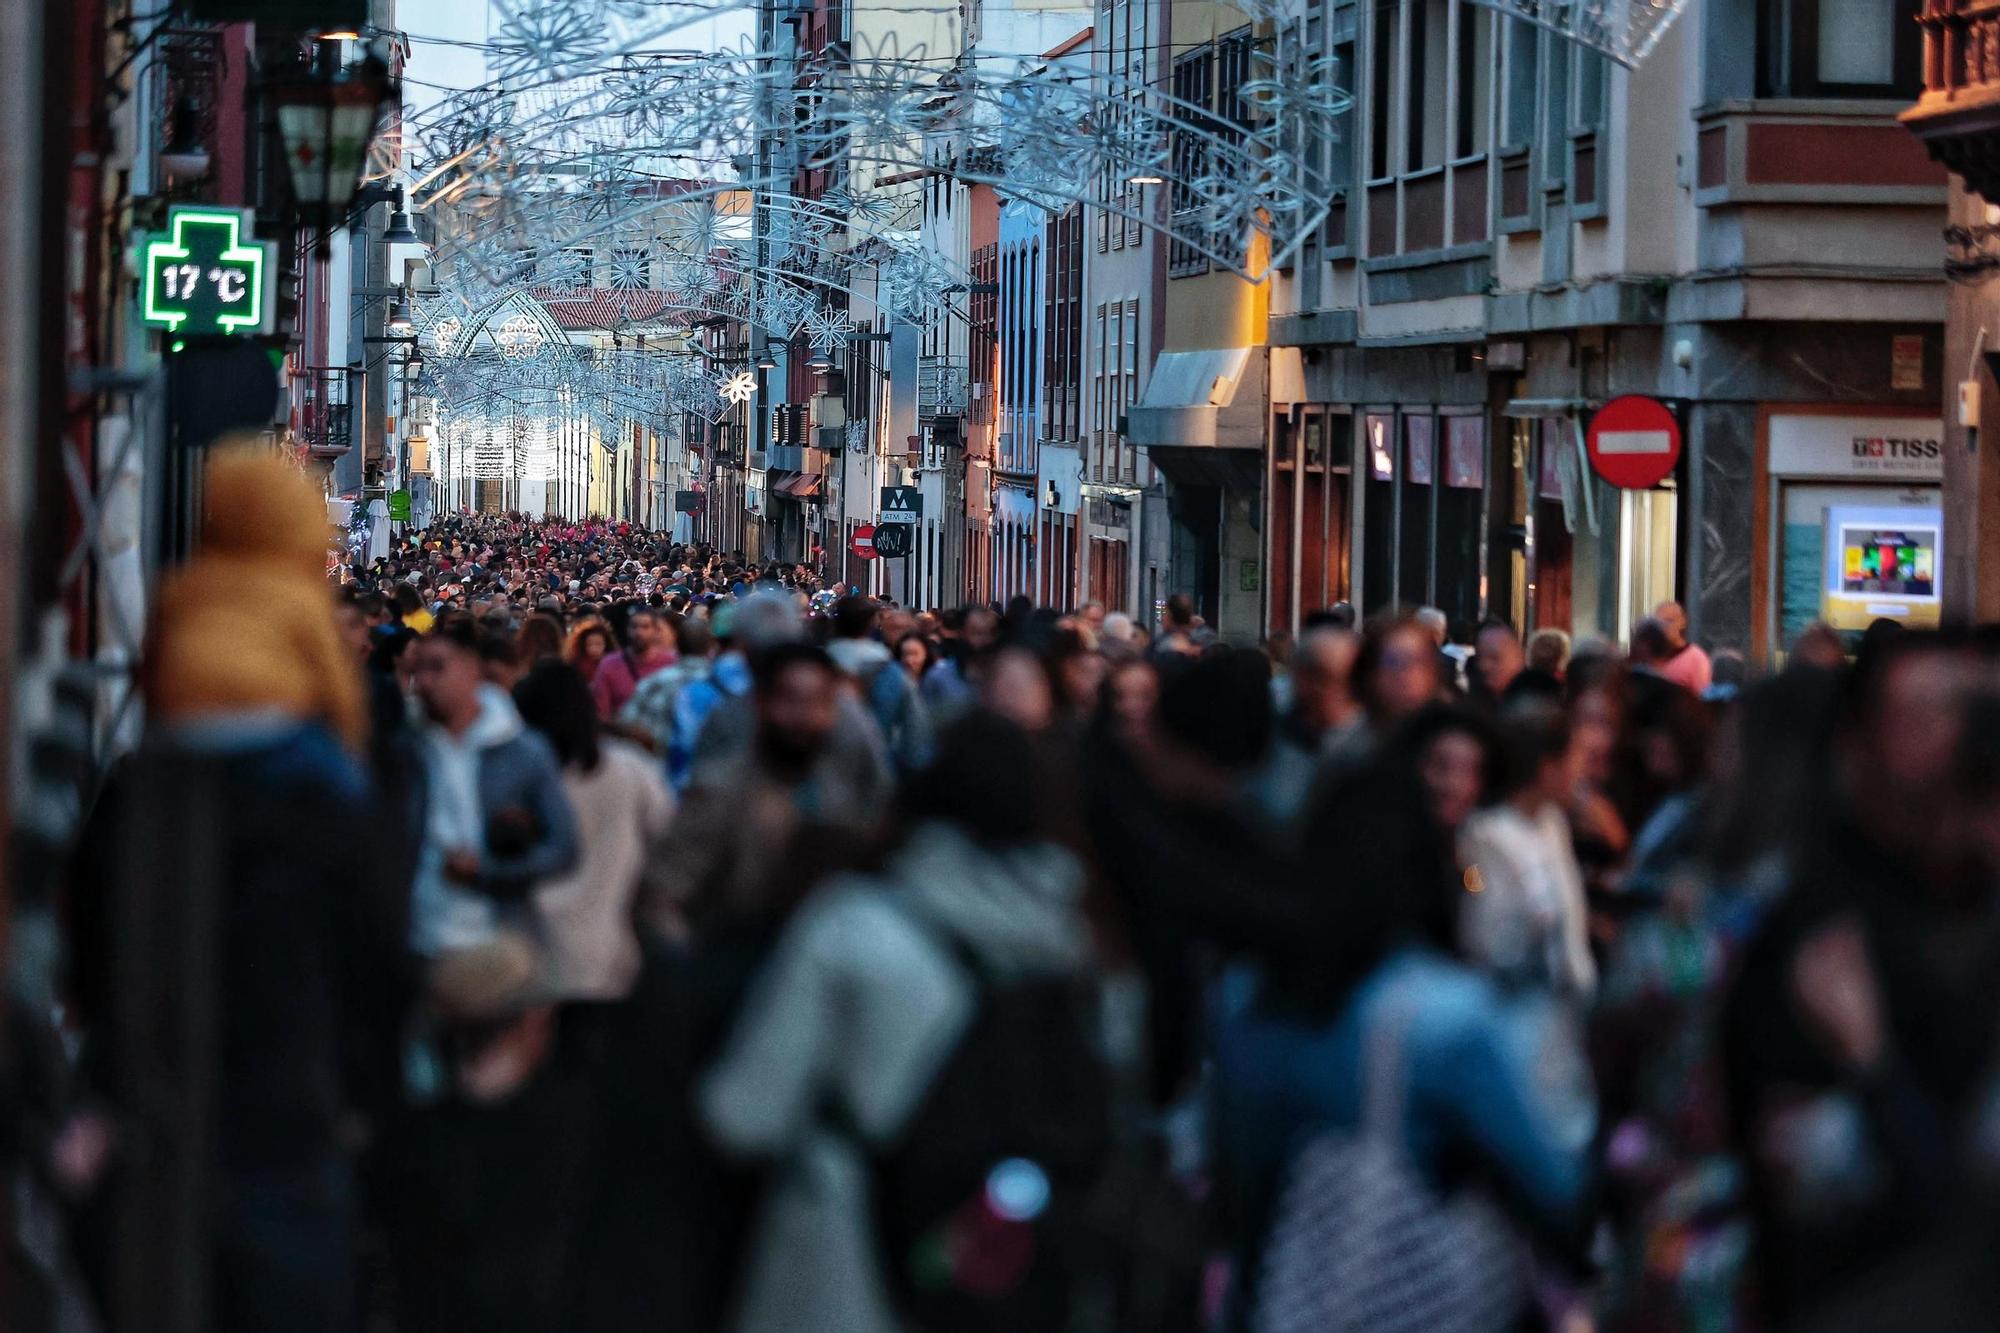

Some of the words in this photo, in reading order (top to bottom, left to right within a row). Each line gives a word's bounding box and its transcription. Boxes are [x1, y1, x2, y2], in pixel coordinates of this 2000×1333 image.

[163, 264, 200, 300] 17
[1886, 438, 1941, 458] TISS
[904, 512, 913, 520] 24
